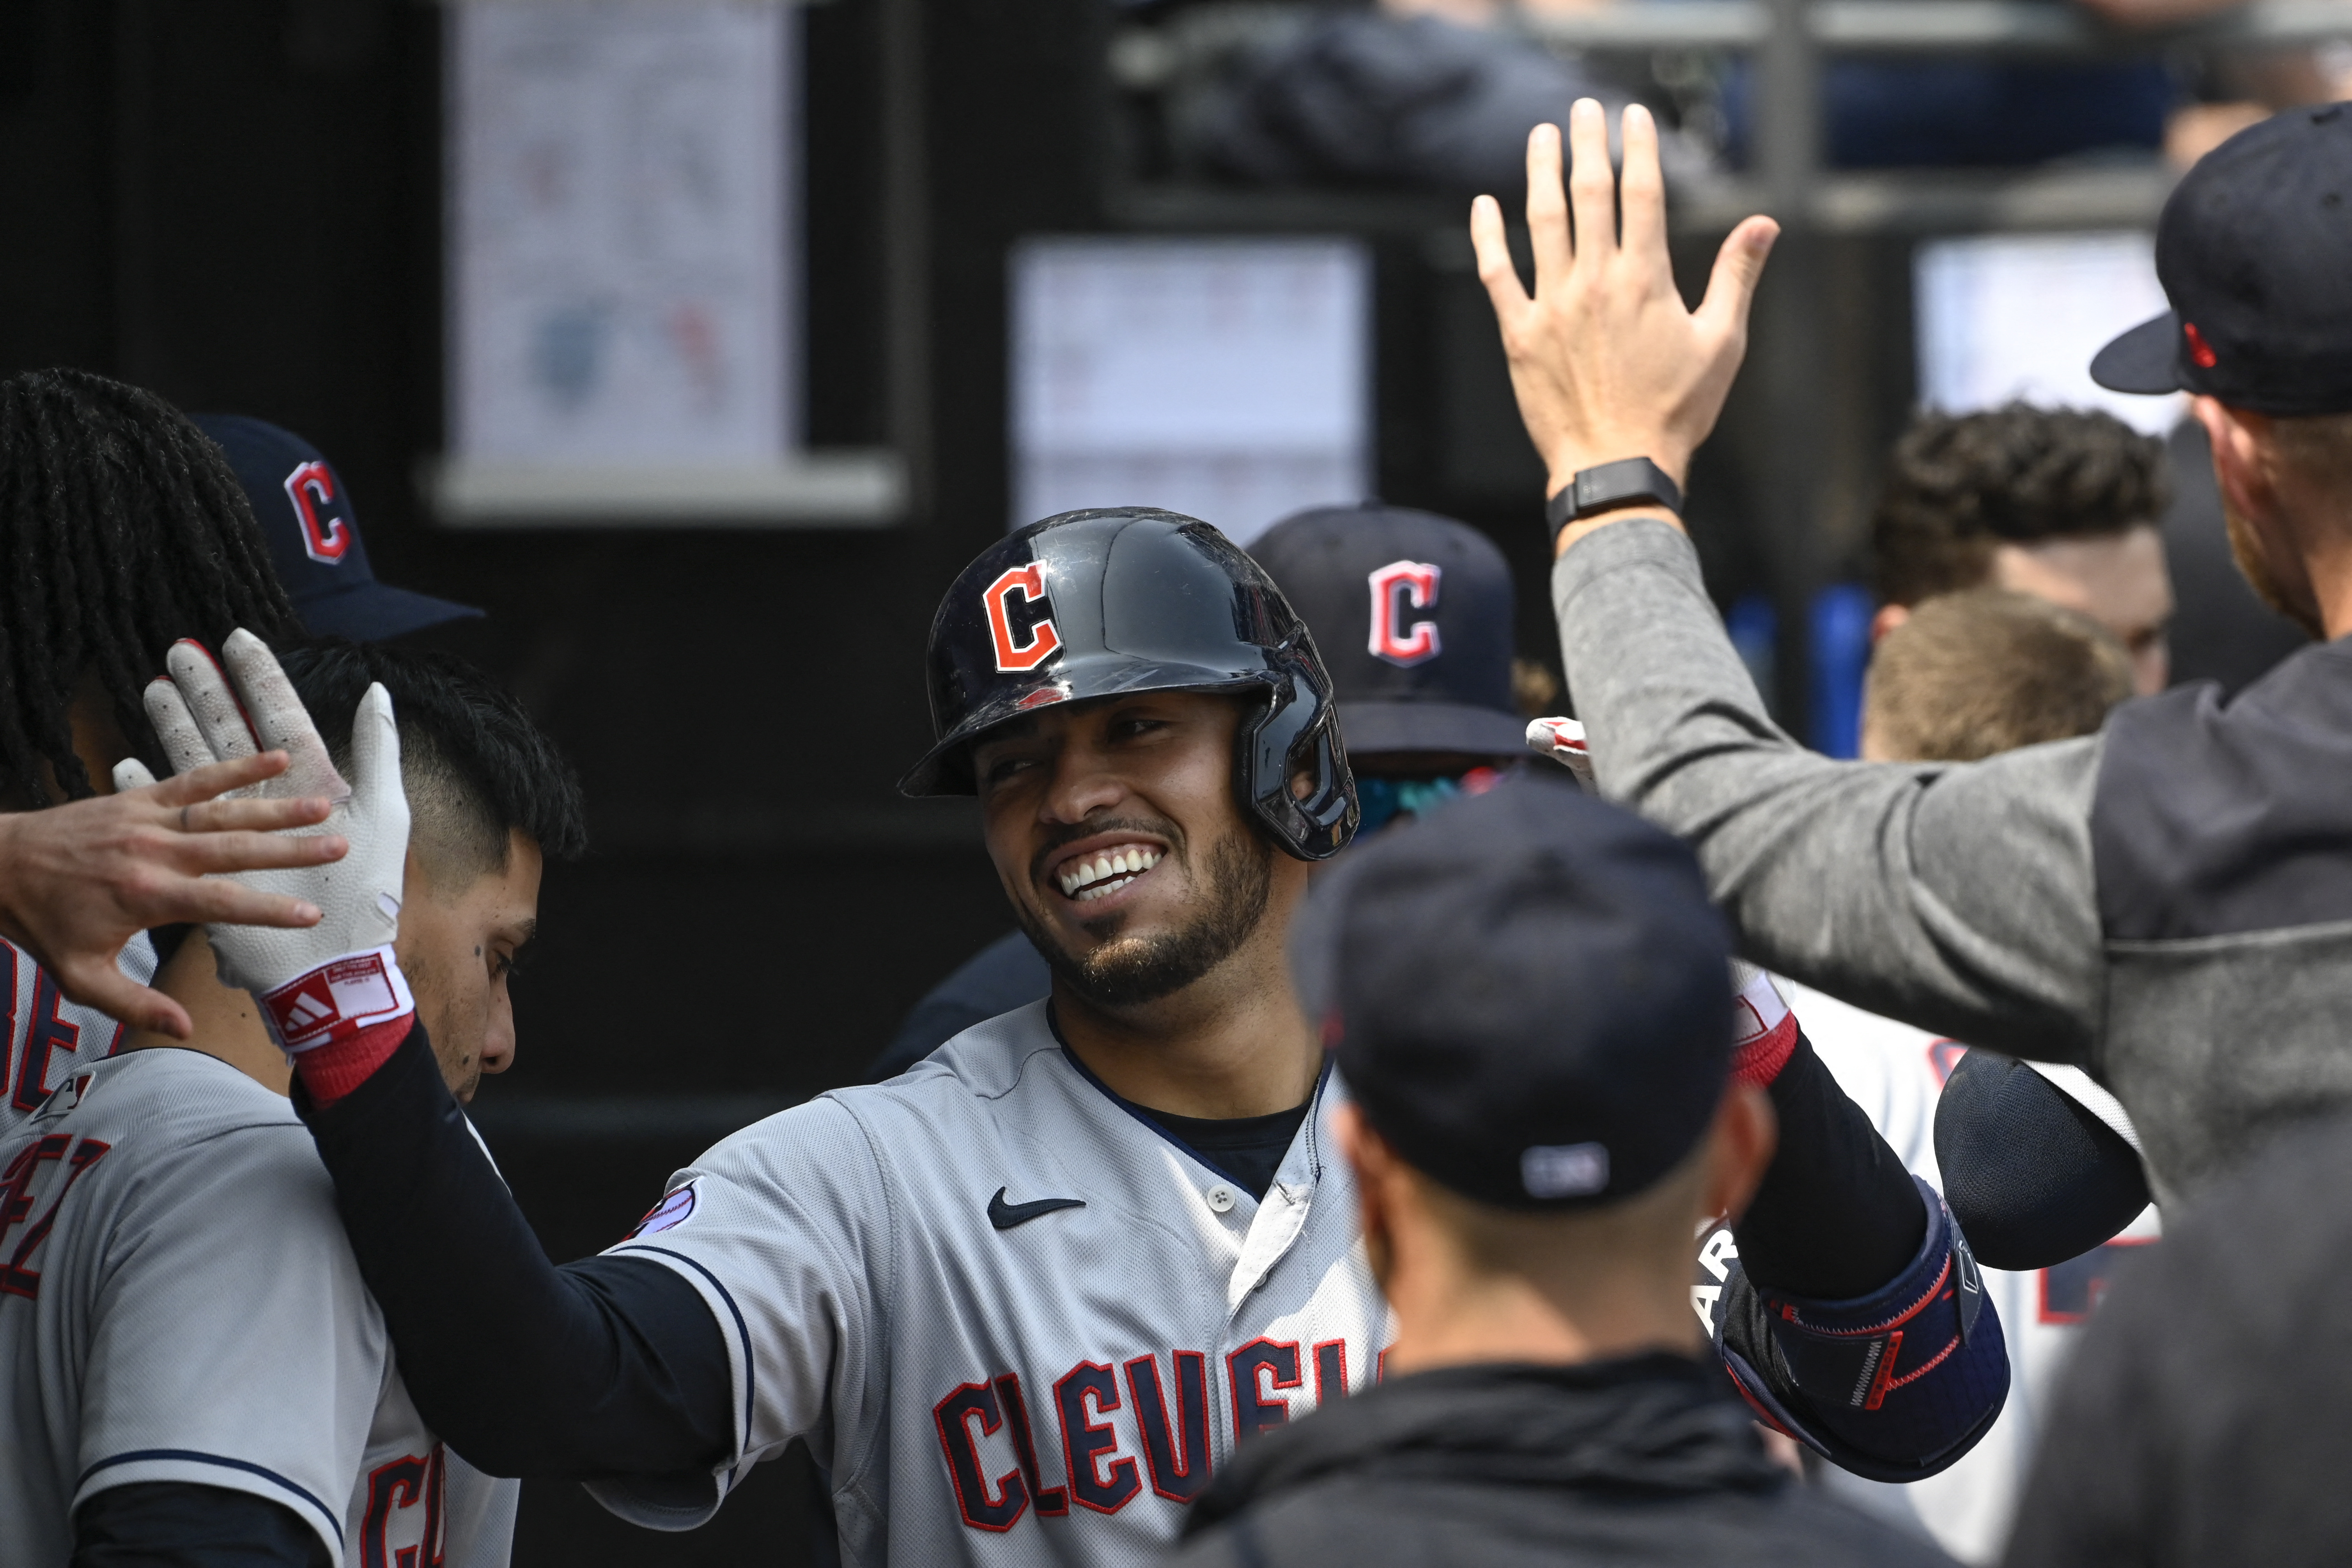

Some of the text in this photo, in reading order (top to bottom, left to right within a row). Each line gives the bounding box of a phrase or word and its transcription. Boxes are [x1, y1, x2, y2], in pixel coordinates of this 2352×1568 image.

[284, 461, 350, 565] C
[982, 559, 1062, 672] C
[1368, 559, 1442, 667] C
[0, 1134, 111, 1300] EZ
[932, 1335, 1397, 1533] CLEVE
